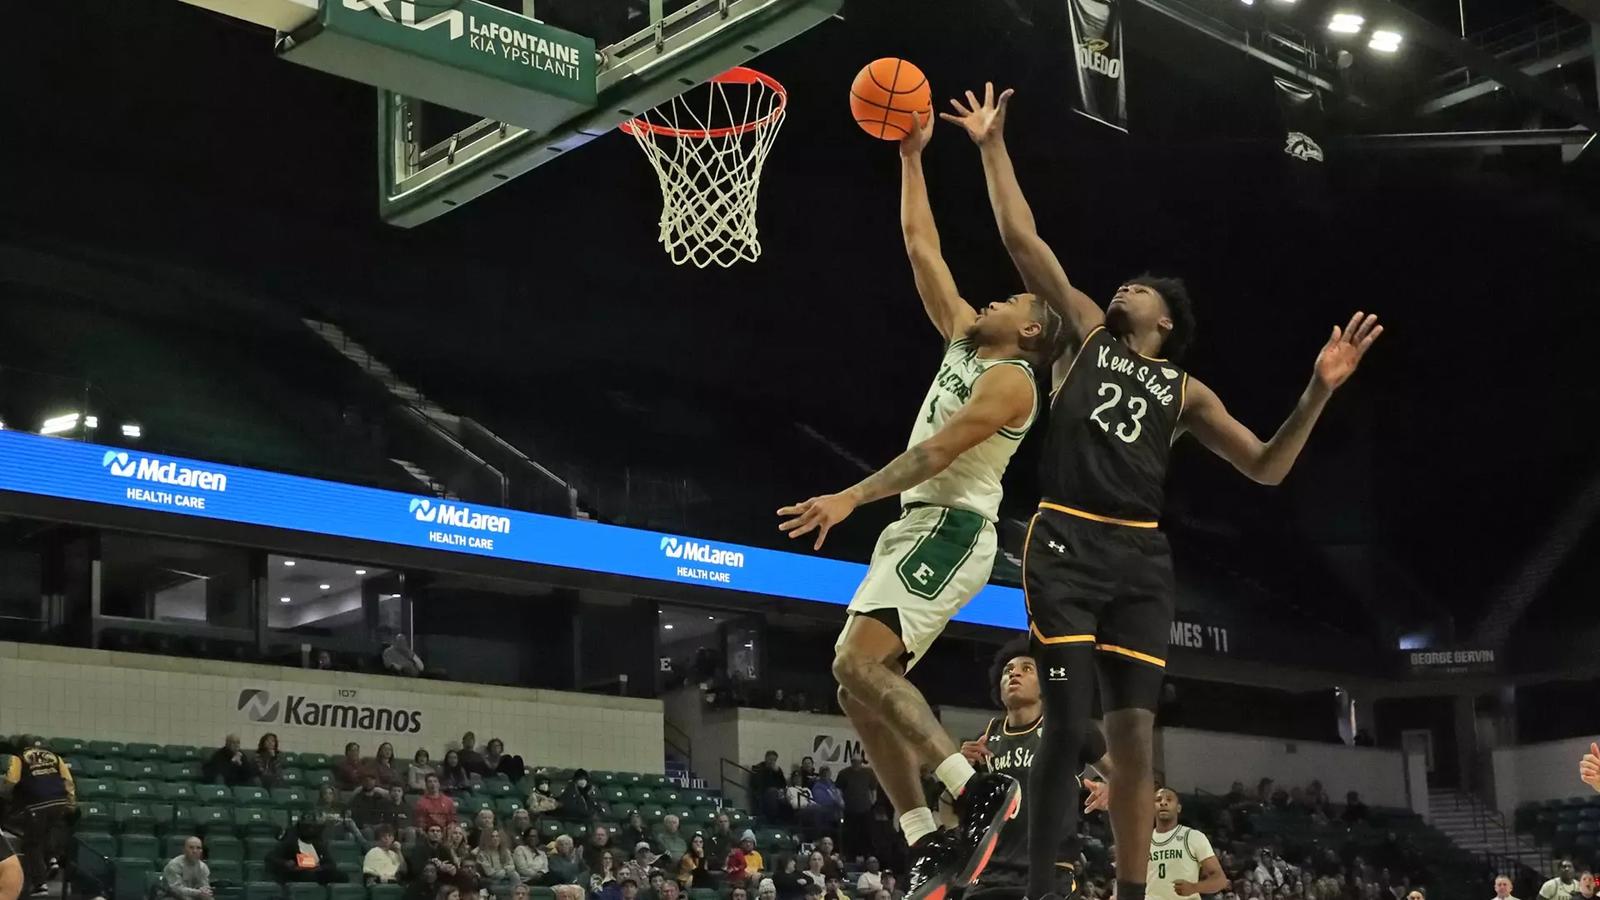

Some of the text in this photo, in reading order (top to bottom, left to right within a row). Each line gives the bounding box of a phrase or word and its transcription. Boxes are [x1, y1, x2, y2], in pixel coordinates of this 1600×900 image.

[470, 36, 580, 81] KIA YPSILANTI
[1078, 44, 1121, 79] OLEDO
[1096, 345, 1174, 406] Kent State
[1089, 382, 1148, 443] 23
[136, 458, 228, 492] McLaren
[126, 487, 206, 510] HEALTH CARE
[436, 503, 511, 534] McLaren
[429, 530, 494, 550] HEALTH CARE
[683, 541, 744, 568] McLaren
[677, 566, 731, 583] HEALTH CARE
[912, 562, 935, 586] E
[1167, 621, 1203, 649] MES
[659, 657, 672, 671] E
[338, 688, 357, 699] 107
[283, 695, 422, 734] Karmanos
[1158, 862, 1166, 879] 0
